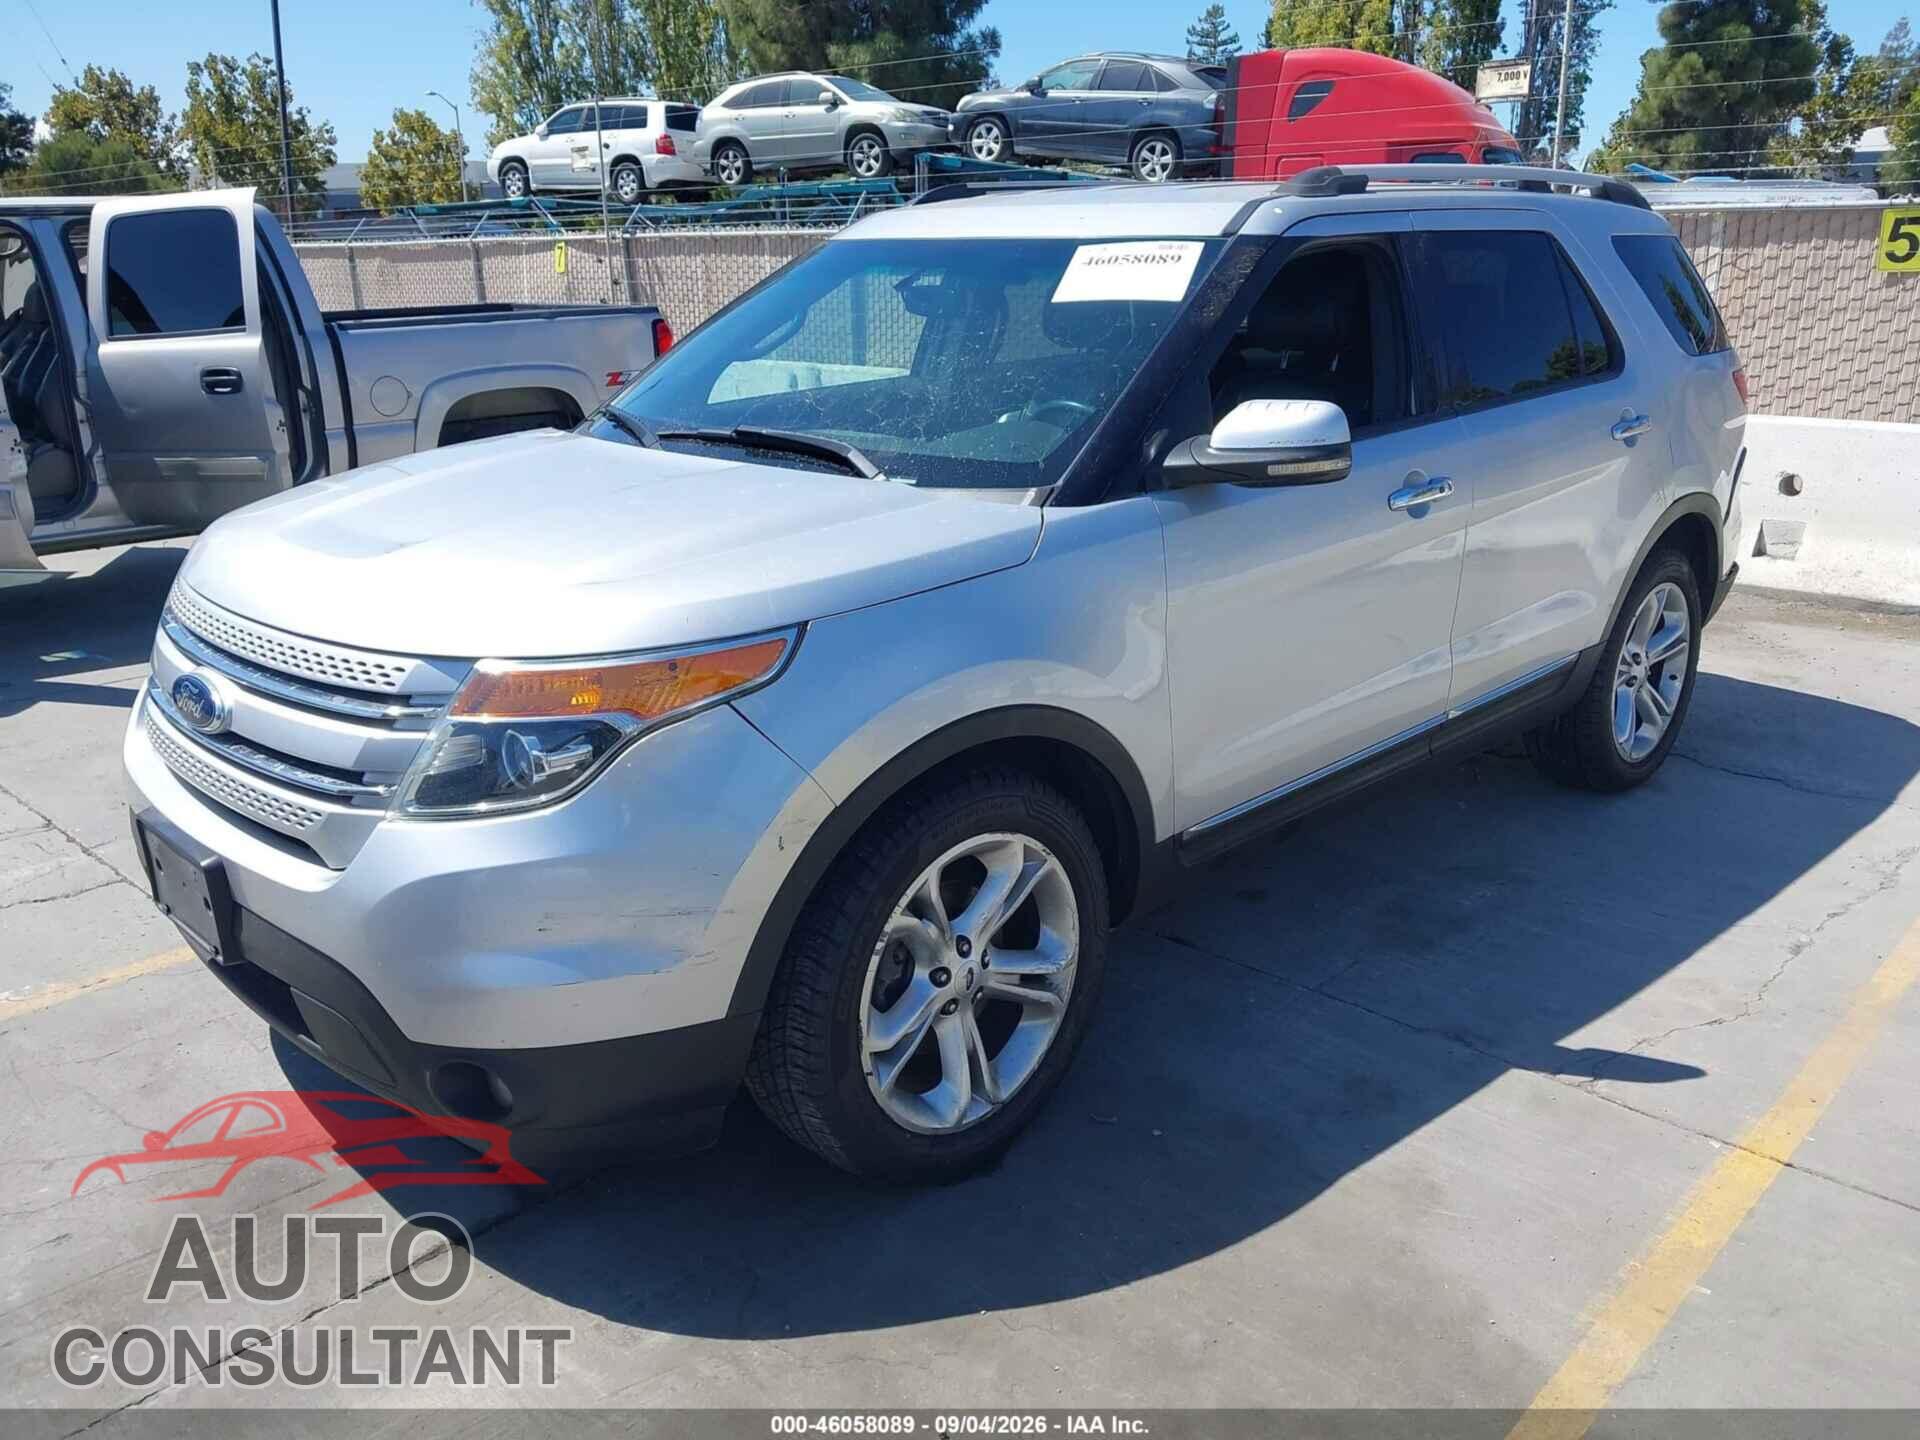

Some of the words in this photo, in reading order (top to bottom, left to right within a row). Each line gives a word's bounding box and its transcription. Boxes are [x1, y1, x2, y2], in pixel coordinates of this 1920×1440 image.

[1496, 70, 1521, 83] 7,000
[1885, 216, 1920, 264] 5
[556, 245, 565, 267] 7
[1081, 253, 1183, 268] 46058089
[176, 680, 205, 719] Ford
